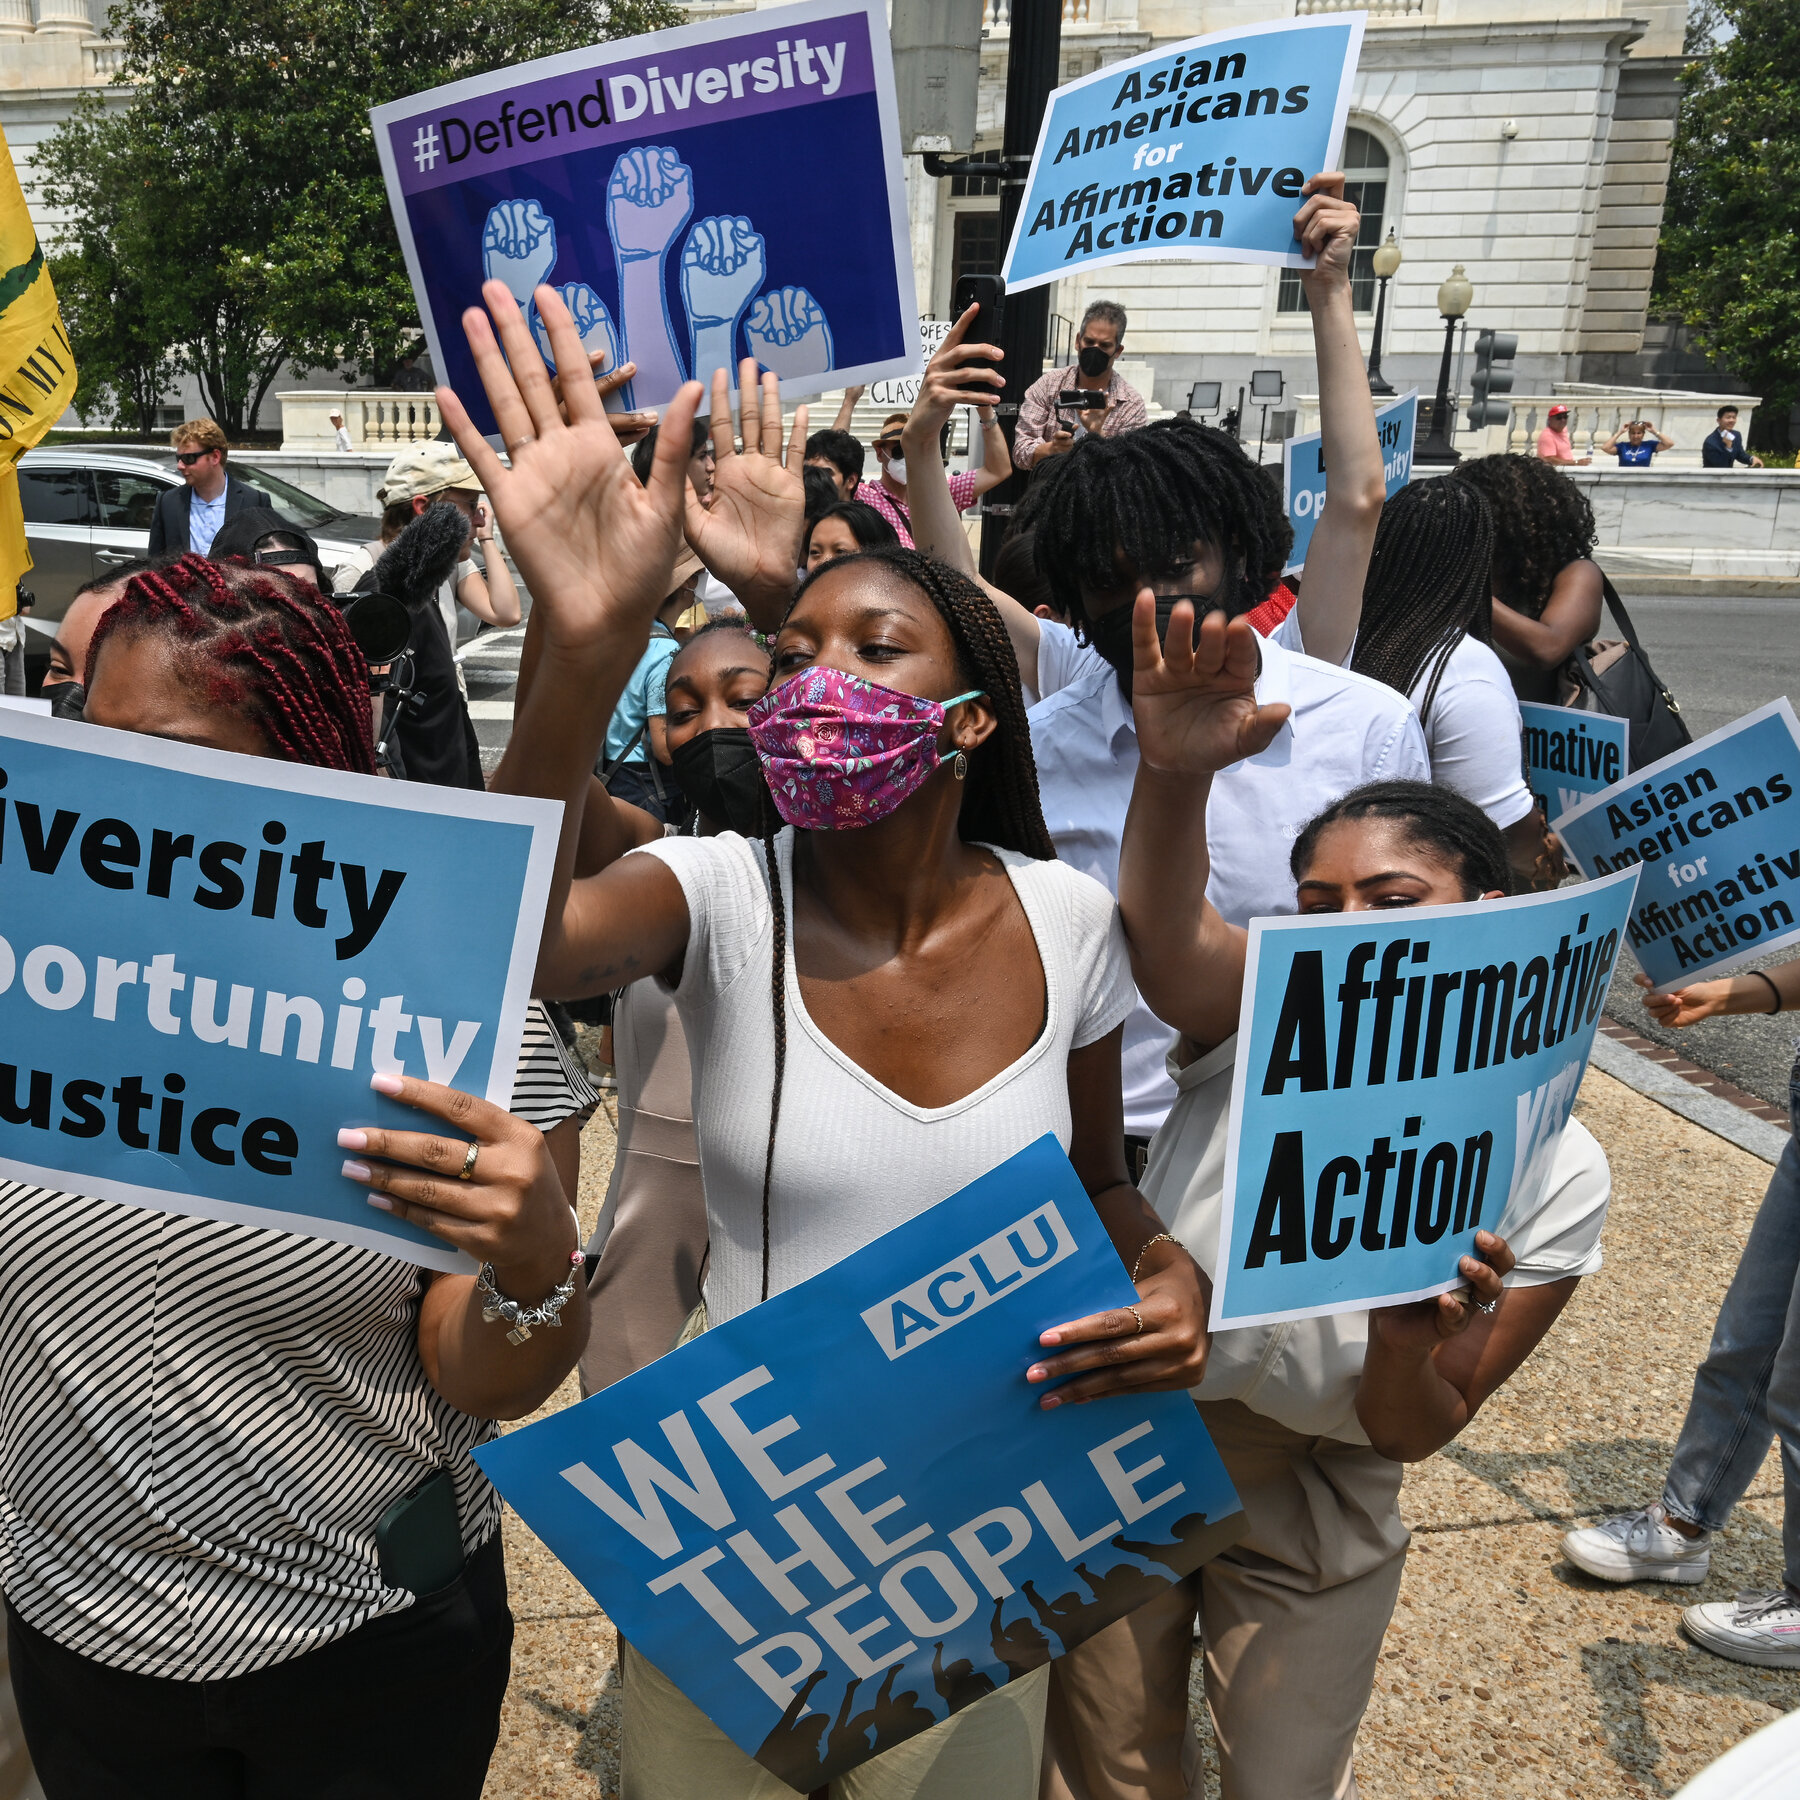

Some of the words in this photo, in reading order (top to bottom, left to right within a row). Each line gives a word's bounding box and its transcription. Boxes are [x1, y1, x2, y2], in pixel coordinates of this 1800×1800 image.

[412, 38, 847, 173] #DefendDiversity
[1052, 85, 1310, 165] Americans
[1111, 52, 1247, 111] Asian
[1028, 157, 1305, 237] Affirmative
[1132, 142, 1183, 171] for
[1064, 205, 1224, 260] Action
[17, 338, 66, 401] MY
[1593, 773, 1793, 878] Americans
[1606, 766, 1718, 839] Asian
[1668, 855, 1708, 888] for
[1669, 899, 1794, 969] Action
[0, 934, 482, 1088] ortunity
[1261, 912, 1618, 1096] Affirmative
[1243, 1116, 1493, 1269] Action
[891, 1214, 1058, 1350] ACLU
[558, 1364, 837, 1560] WE
[646, 1456, 935, 1646] THE
[733, 1420, 1186, 1717] PEOPLE
